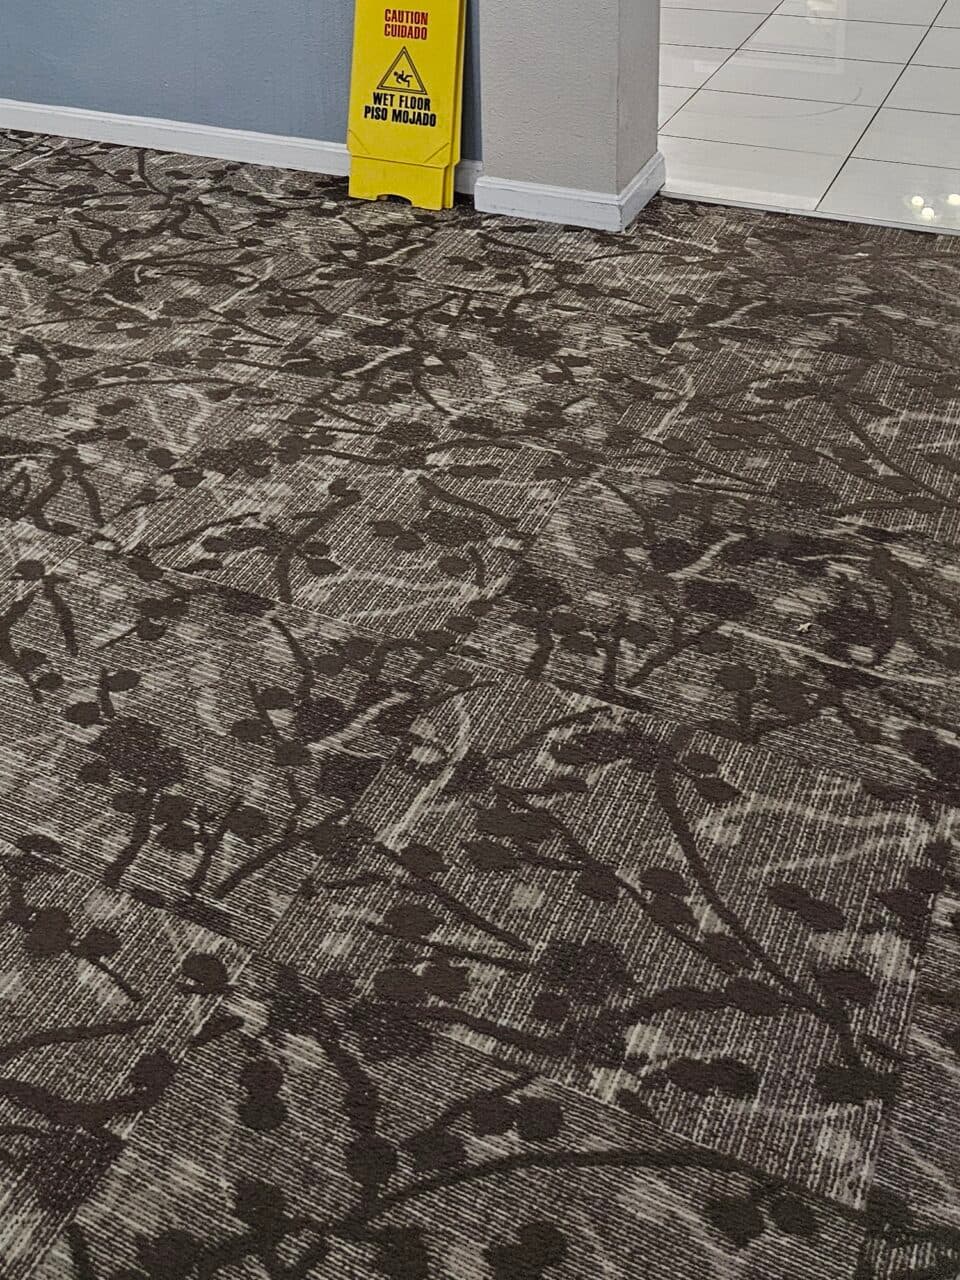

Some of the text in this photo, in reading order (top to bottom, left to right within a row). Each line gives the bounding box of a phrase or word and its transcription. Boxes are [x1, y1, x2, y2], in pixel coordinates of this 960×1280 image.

[384, 8, 429, 26] CAUTION
[384, 23, 428, 41] CUIDADO
[373, 92, 431, 111] WET FLOOR
[364, 105, 437, 127] PISO MOJADO
